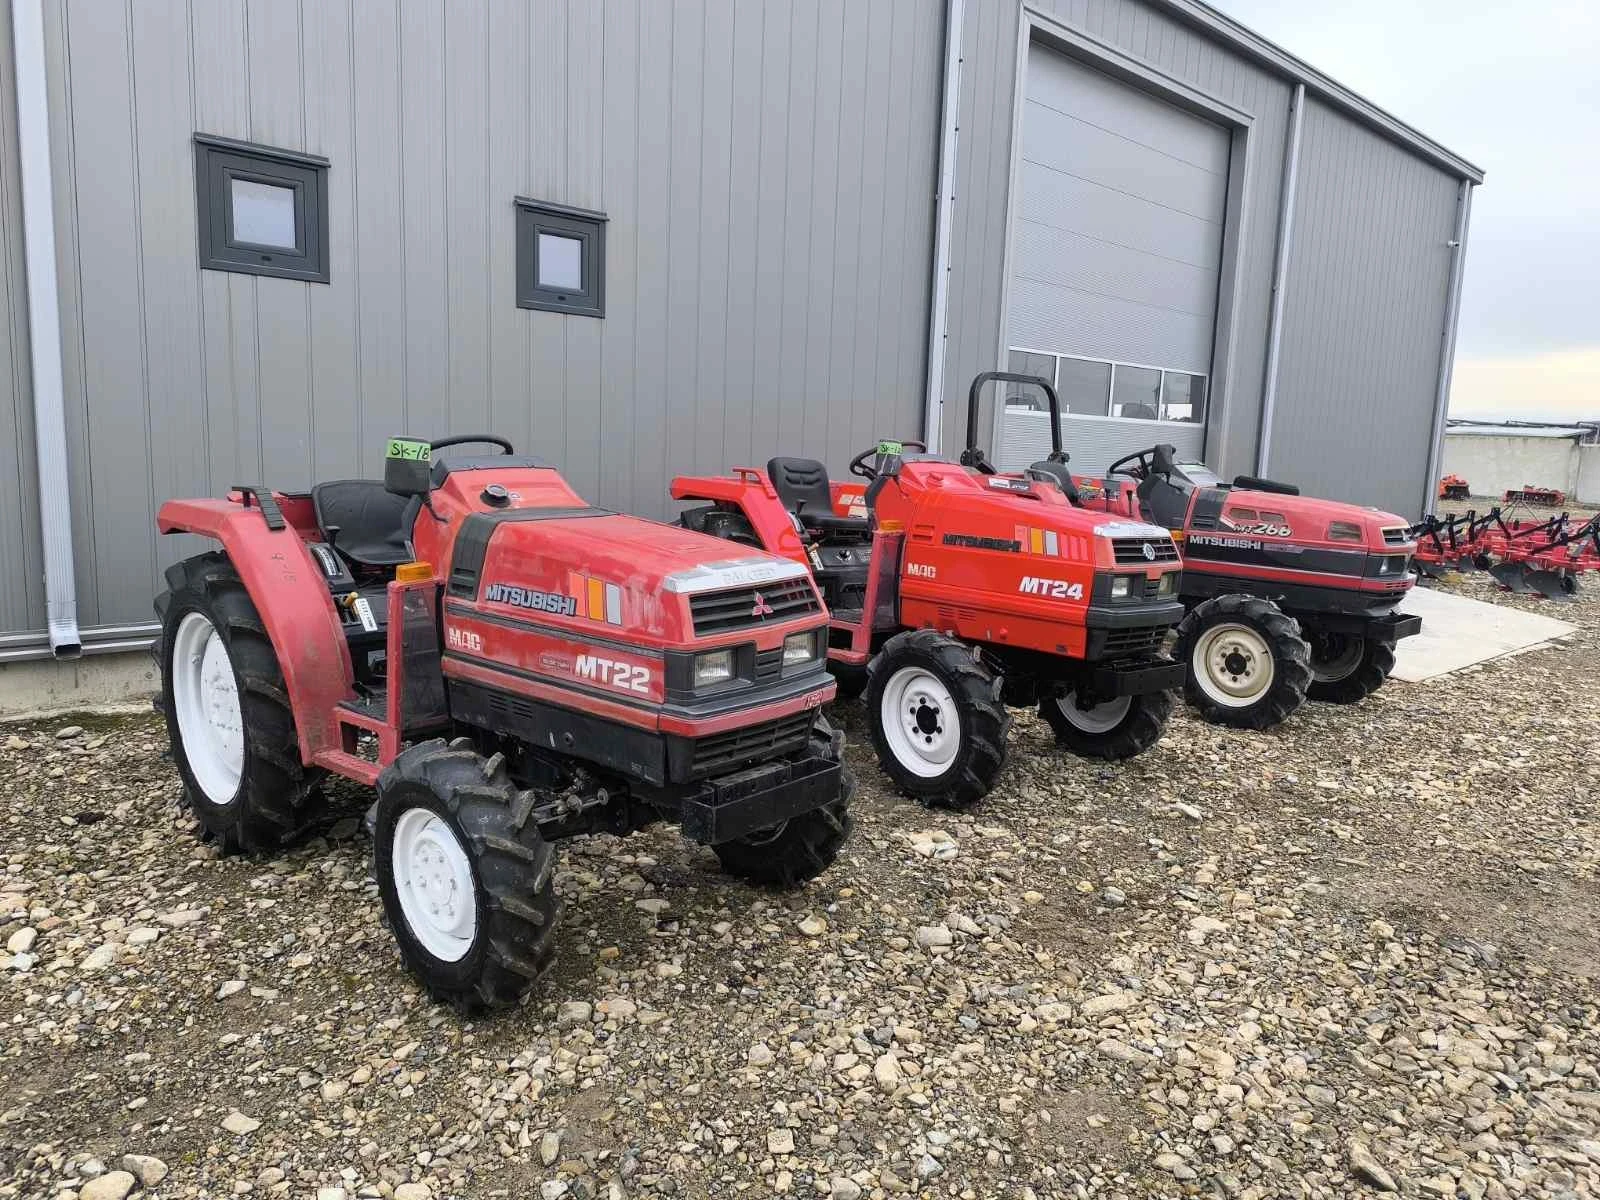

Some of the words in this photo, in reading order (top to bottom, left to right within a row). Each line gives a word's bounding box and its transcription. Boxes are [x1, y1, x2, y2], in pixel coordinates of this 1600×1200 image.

[1190, 535, 1262, 550] MITSUBISHI
[485, 584, 577, 617] MITSUBISHI
[1019, 577, 1084, 600] MT24
[574, 655, 650, 694] MT22
